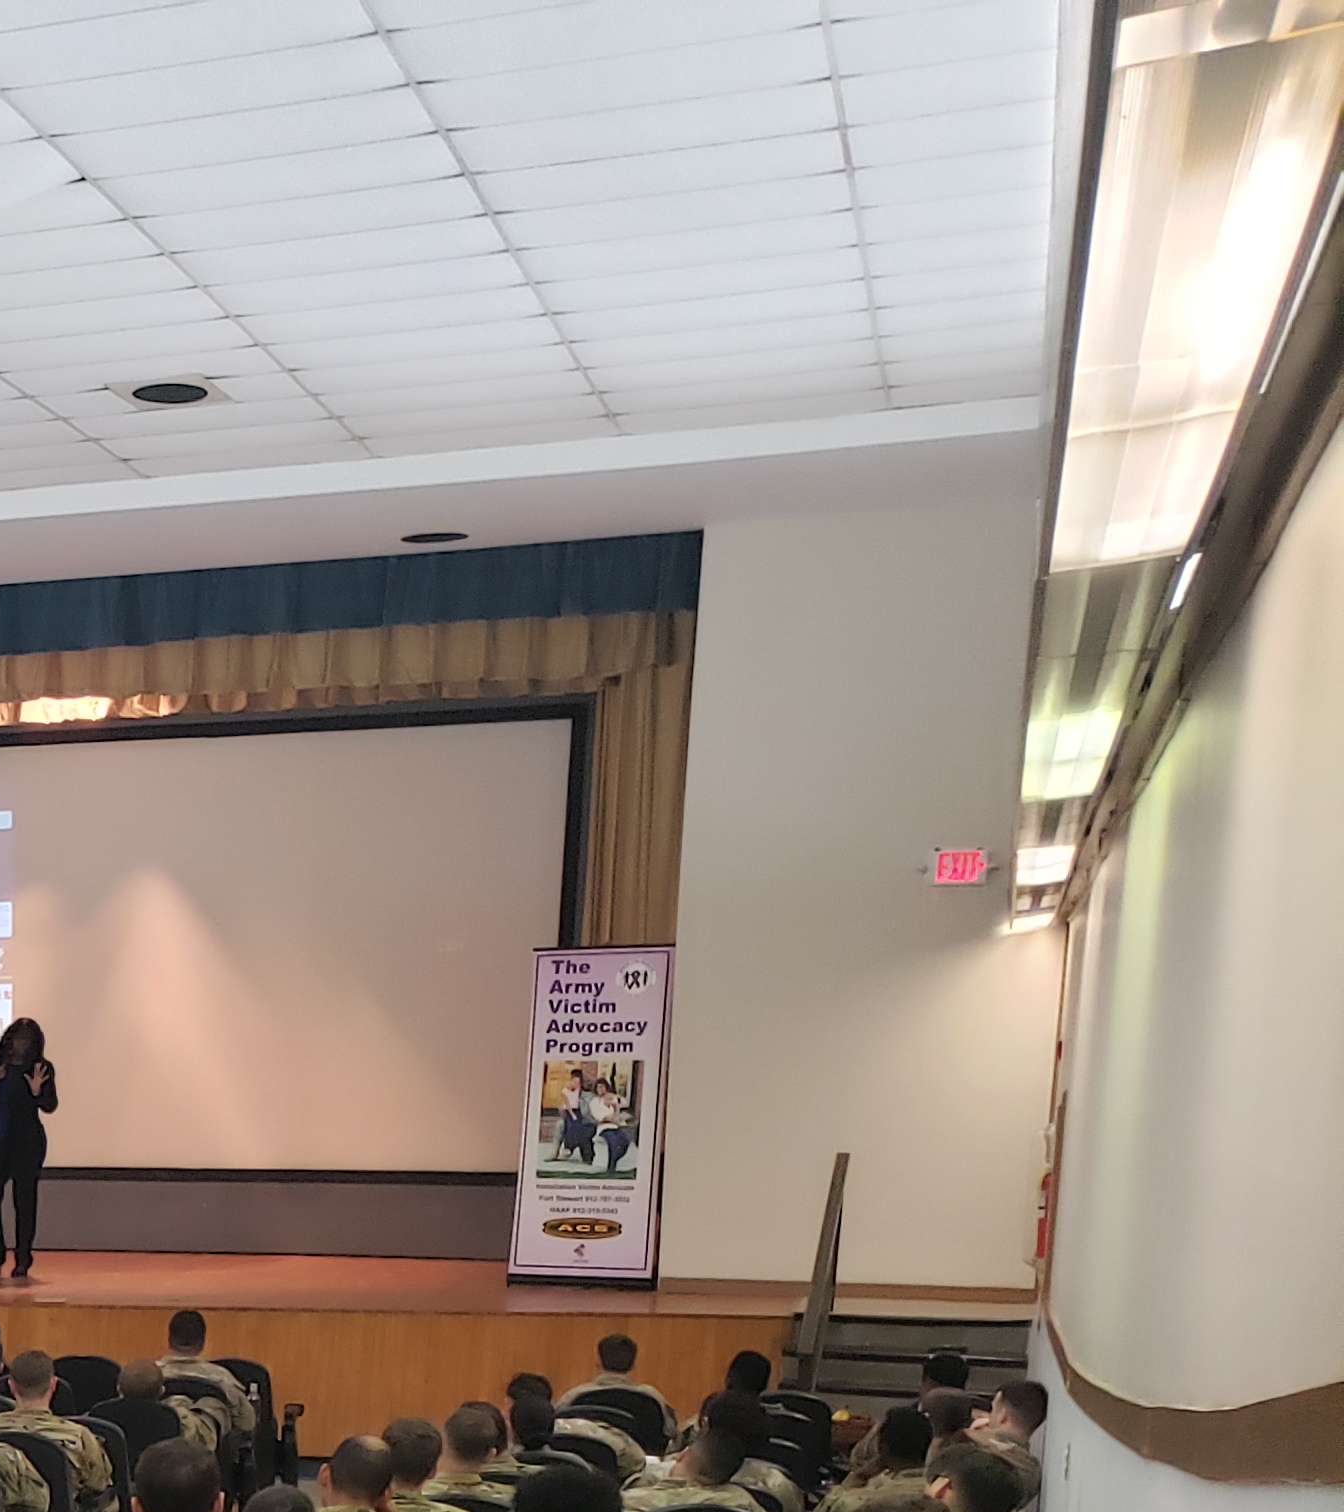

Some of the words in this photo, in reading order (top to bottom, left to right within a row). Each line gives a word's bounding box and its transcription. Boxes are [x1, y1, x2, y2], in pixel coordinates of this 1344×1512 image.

[936, 851, 981, 883] EXIT
[551, 960, 590, 975] The
[549, 979, 605, 997] Army
[548, 999, 617, 1014] Victim
[546, 1019, 648, 1036] Advocacy
[545, 1039, 634, 1057] Program
